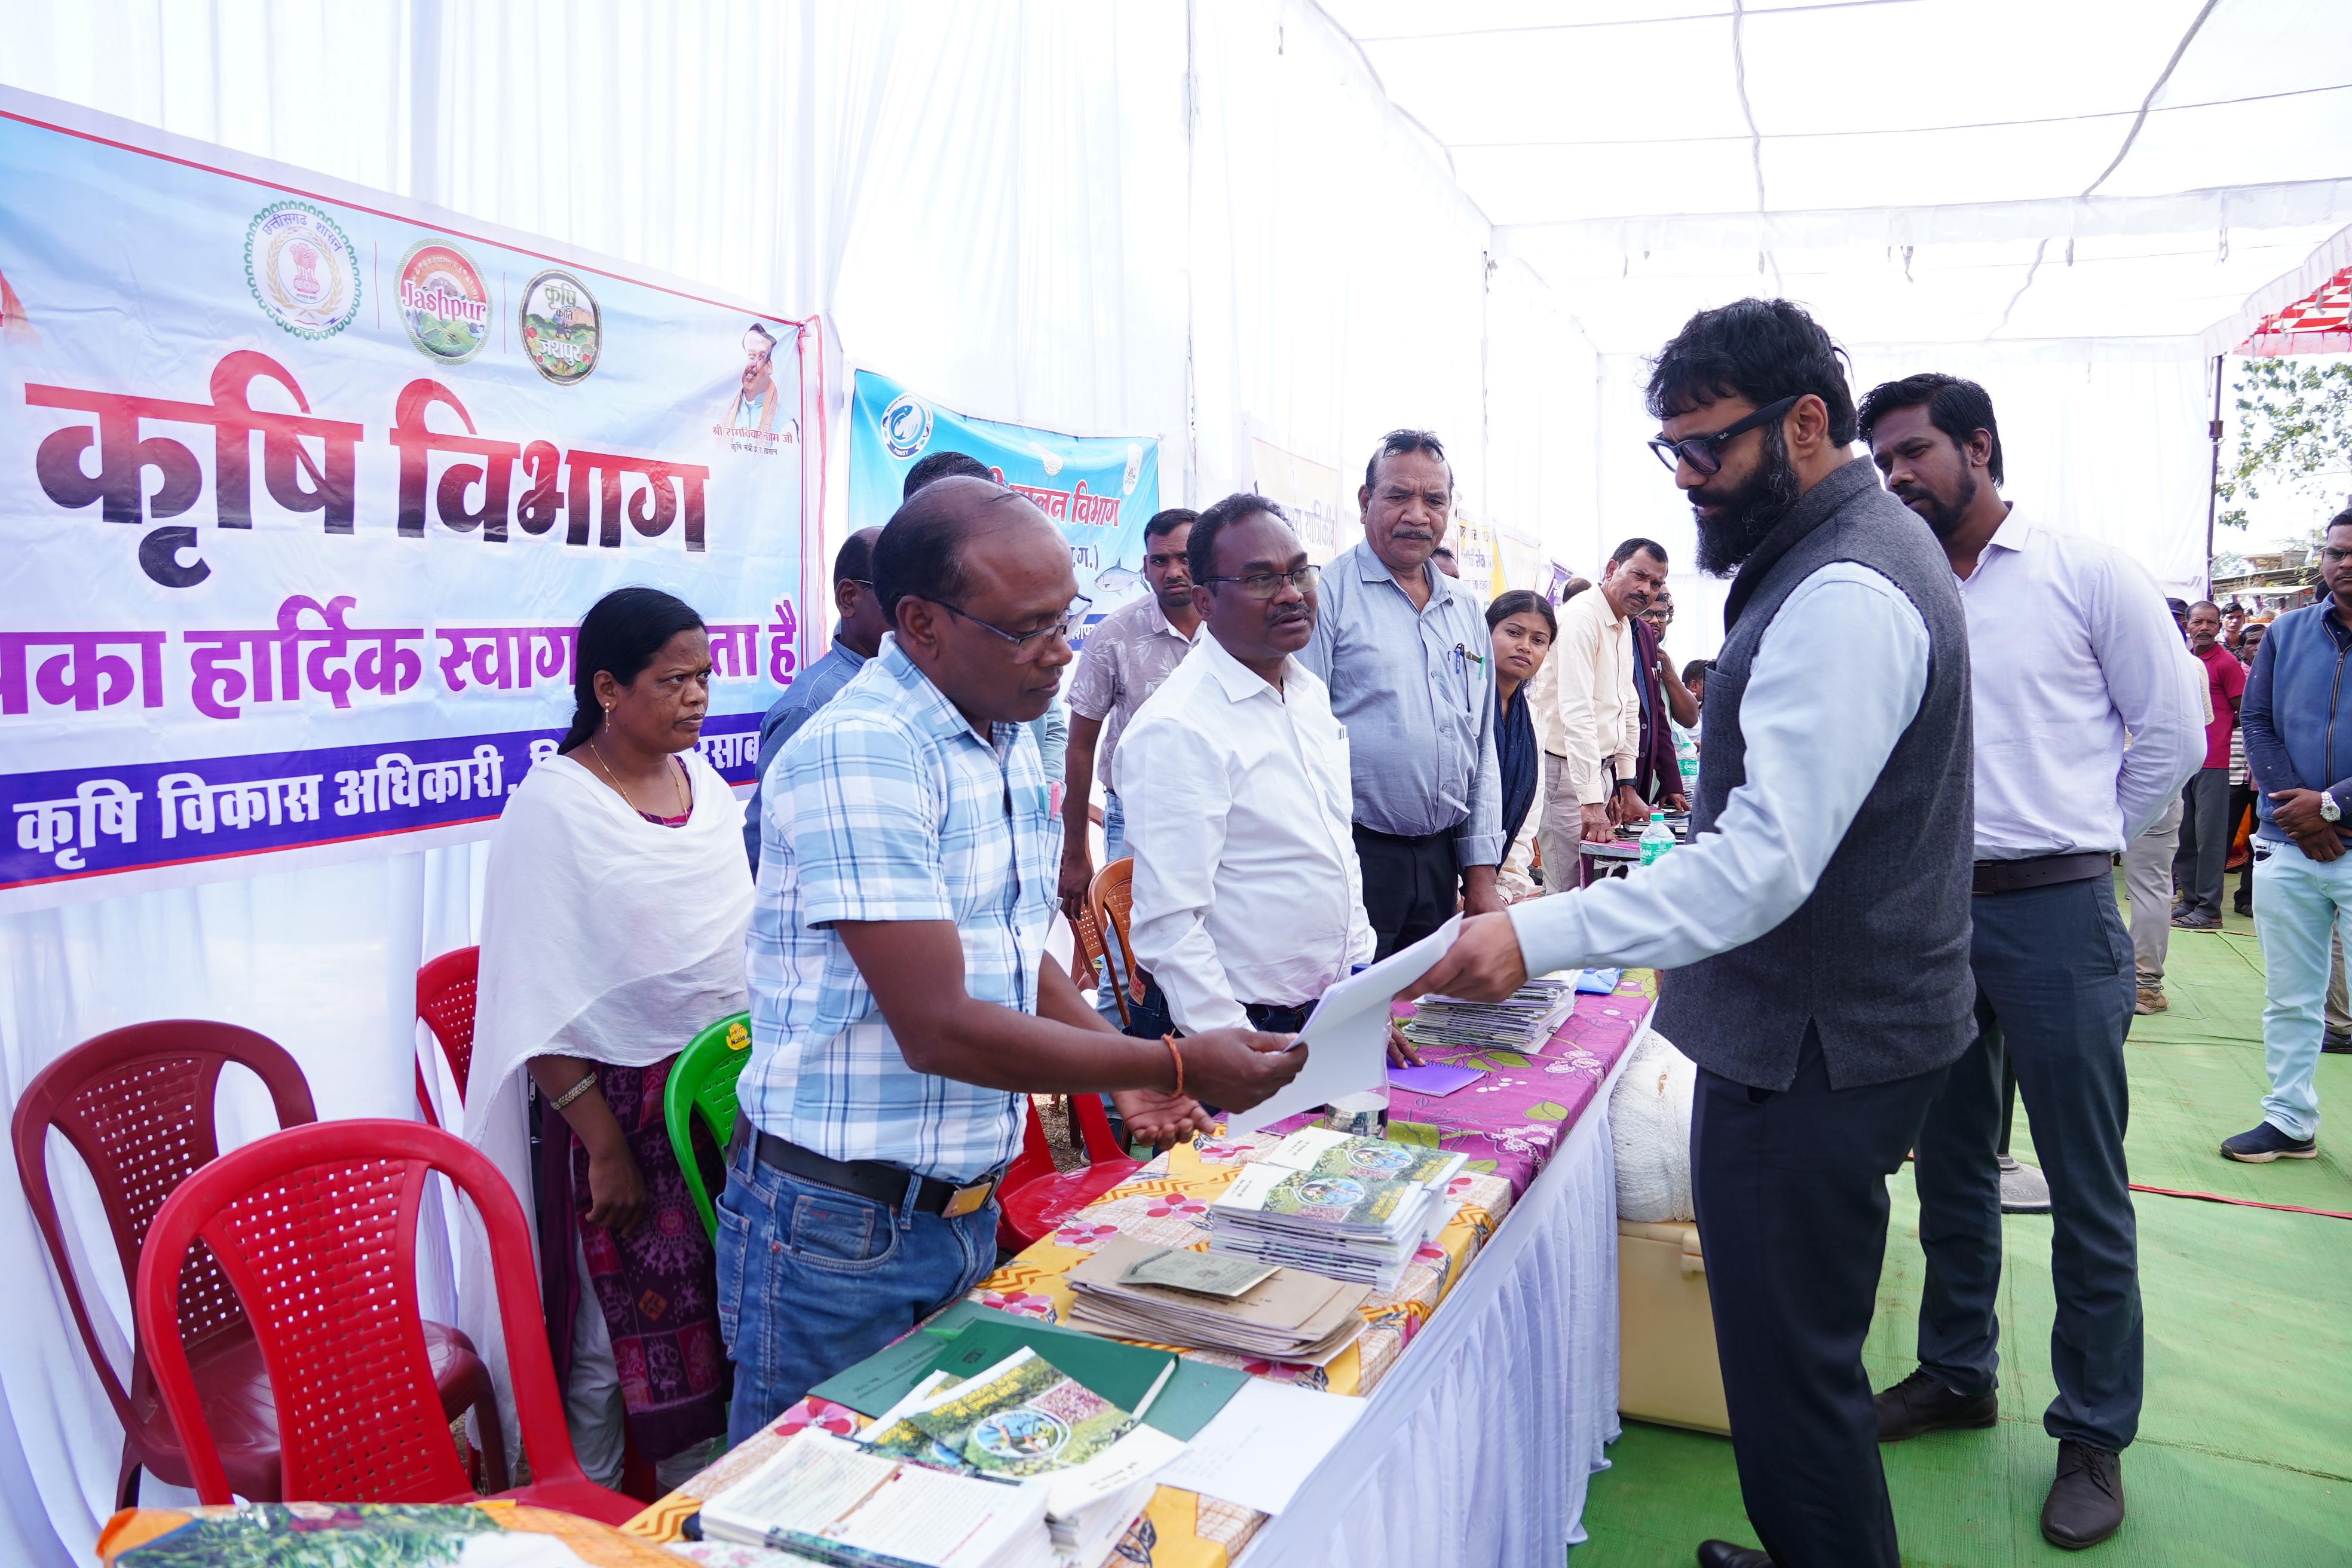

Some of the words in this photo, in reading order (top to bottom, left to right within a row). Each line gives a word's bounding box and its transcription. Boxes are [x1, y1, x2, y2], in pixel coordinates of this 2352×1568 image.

[402, 281, 486, 321] Jashpur
[544, 283, 577, 310] कृषि
[539, 339, 581, 366] जशपुर
[713, 424, 722, 436] श्री
[725, 426, 761, 439] रामविचार
[782, 432, 792, 443] जी
[24, 350, 364, 588] कृषि
[390, 378, 709, 553] विभाग
[1071, 480, 1120, 527] विभाग
[184, 595, 424, 719] हार्दिक
[436, 626, 581, 692] स्वाग
[768, 599, 797, 685] है
[13, 779, 143, 870] कृषि
[157, 773, 323, 839] विकास
